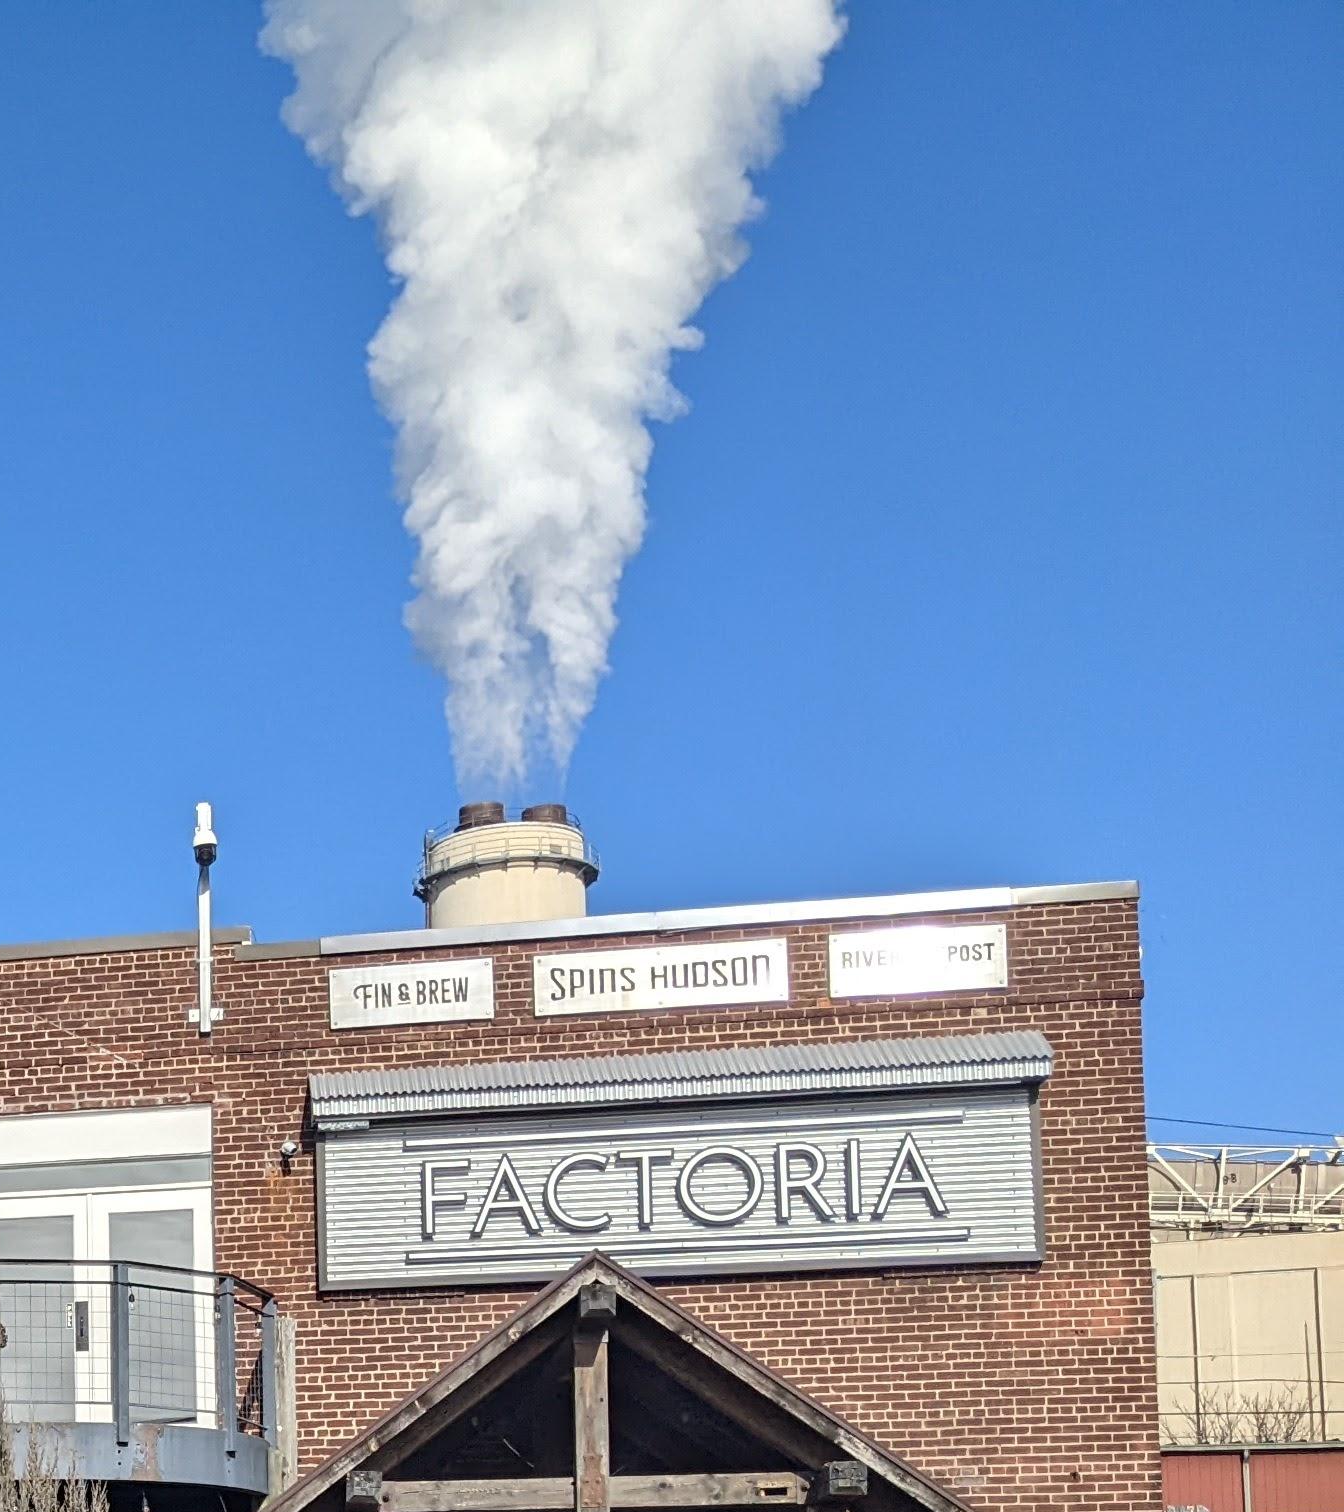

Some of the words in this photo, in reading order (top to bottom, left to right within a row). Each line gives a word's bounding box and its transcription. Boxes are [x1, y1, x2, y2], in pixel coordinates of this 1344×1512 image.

[353, 982, 393, 1010] FIN
[397, 983, 411, 1006] &
[416, 976, 469, 1006] BREW
[419, 1132, 950, 1241] FACTORIA
